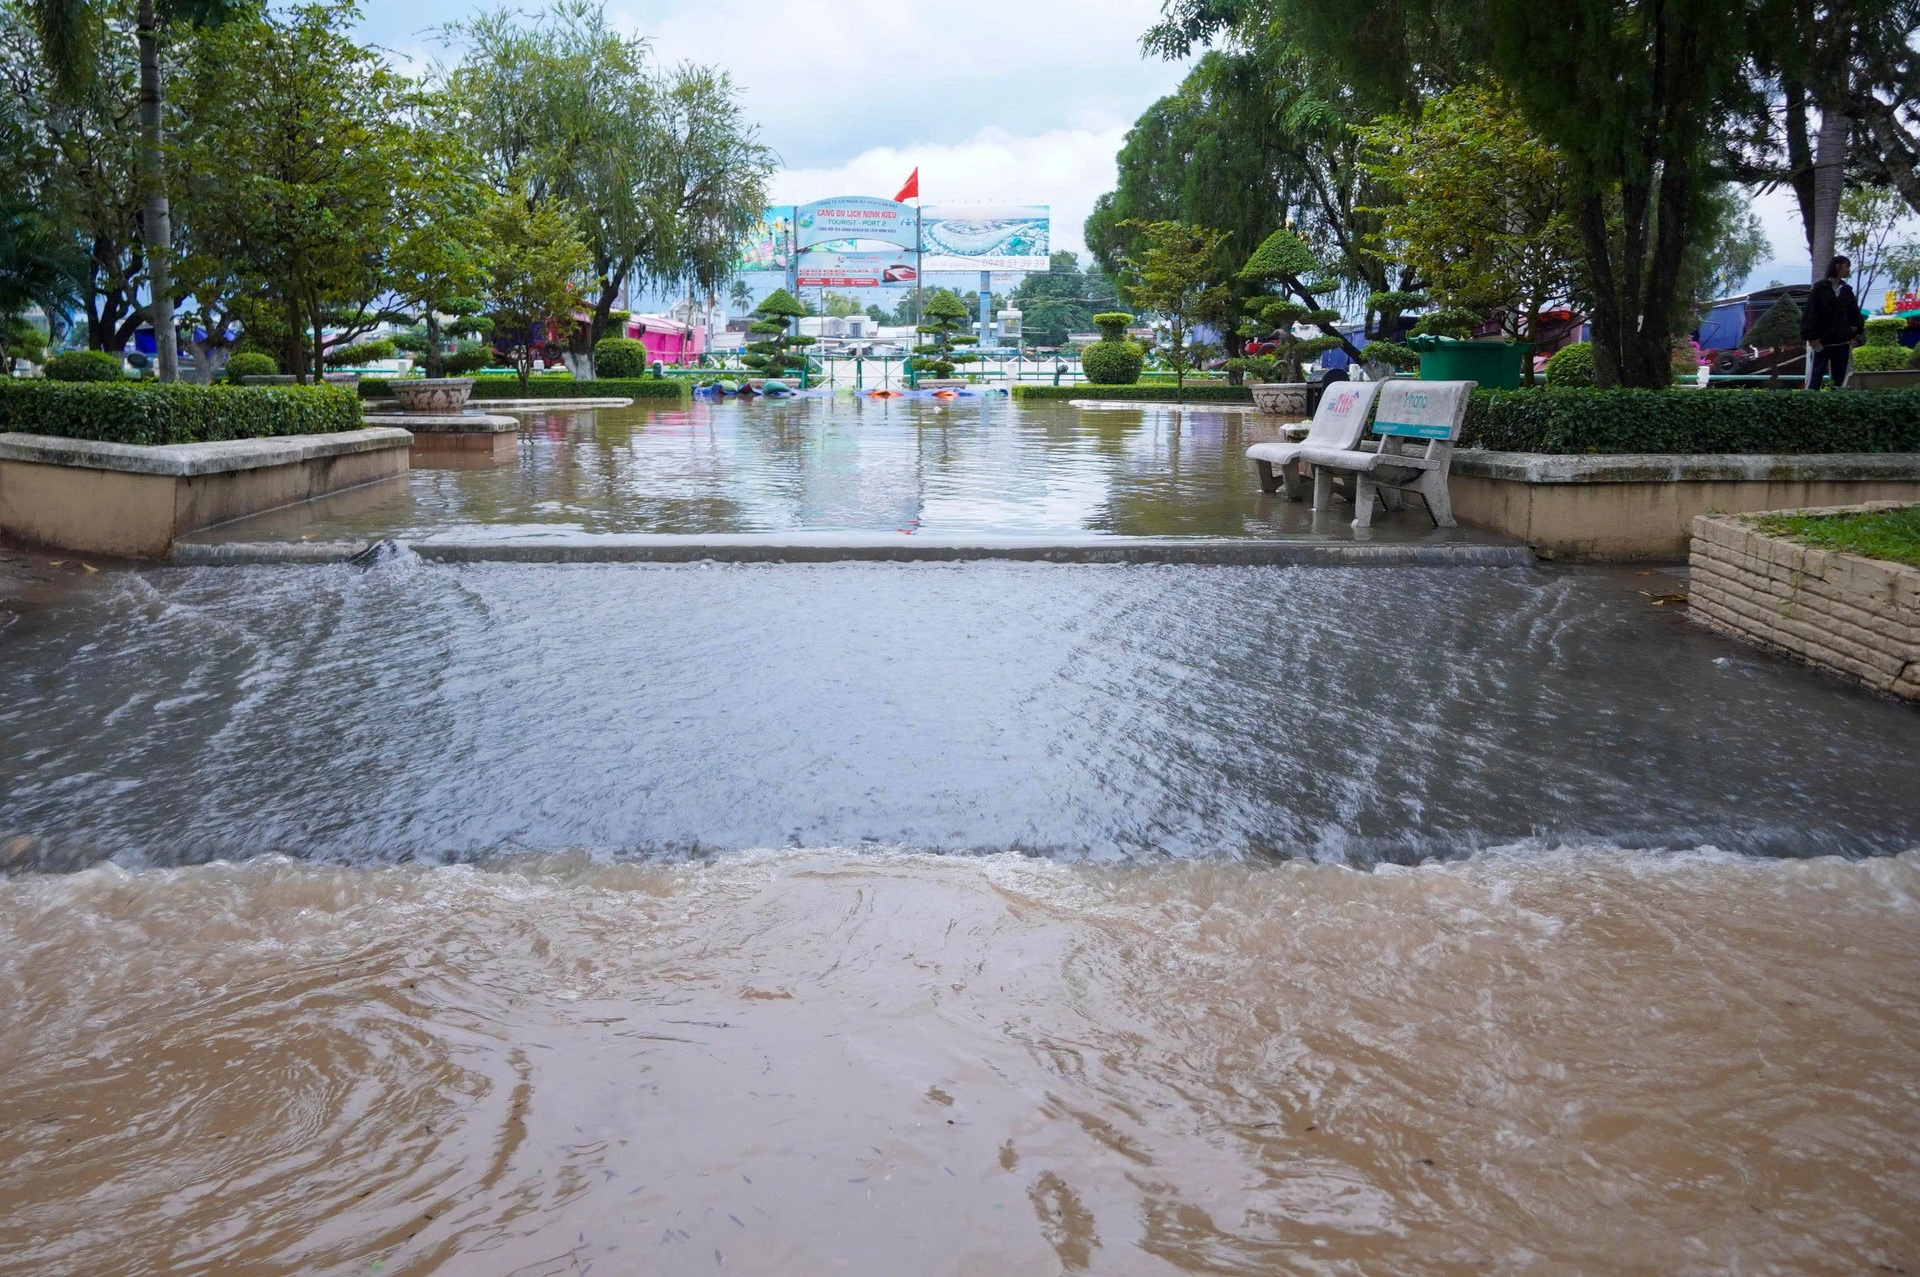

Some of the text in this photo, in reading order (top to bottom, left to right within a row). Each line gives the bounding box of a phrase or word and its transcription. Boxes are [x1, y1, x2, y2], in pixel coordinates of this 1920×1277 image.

[862, 210, 880, 218] NINH
[982, 259, 1005, 268] 0949
[1007, 259, 1017, 267] 51
[1020, 259, 1032, 268] 39
[1033, 259, 1046, 268] 39
